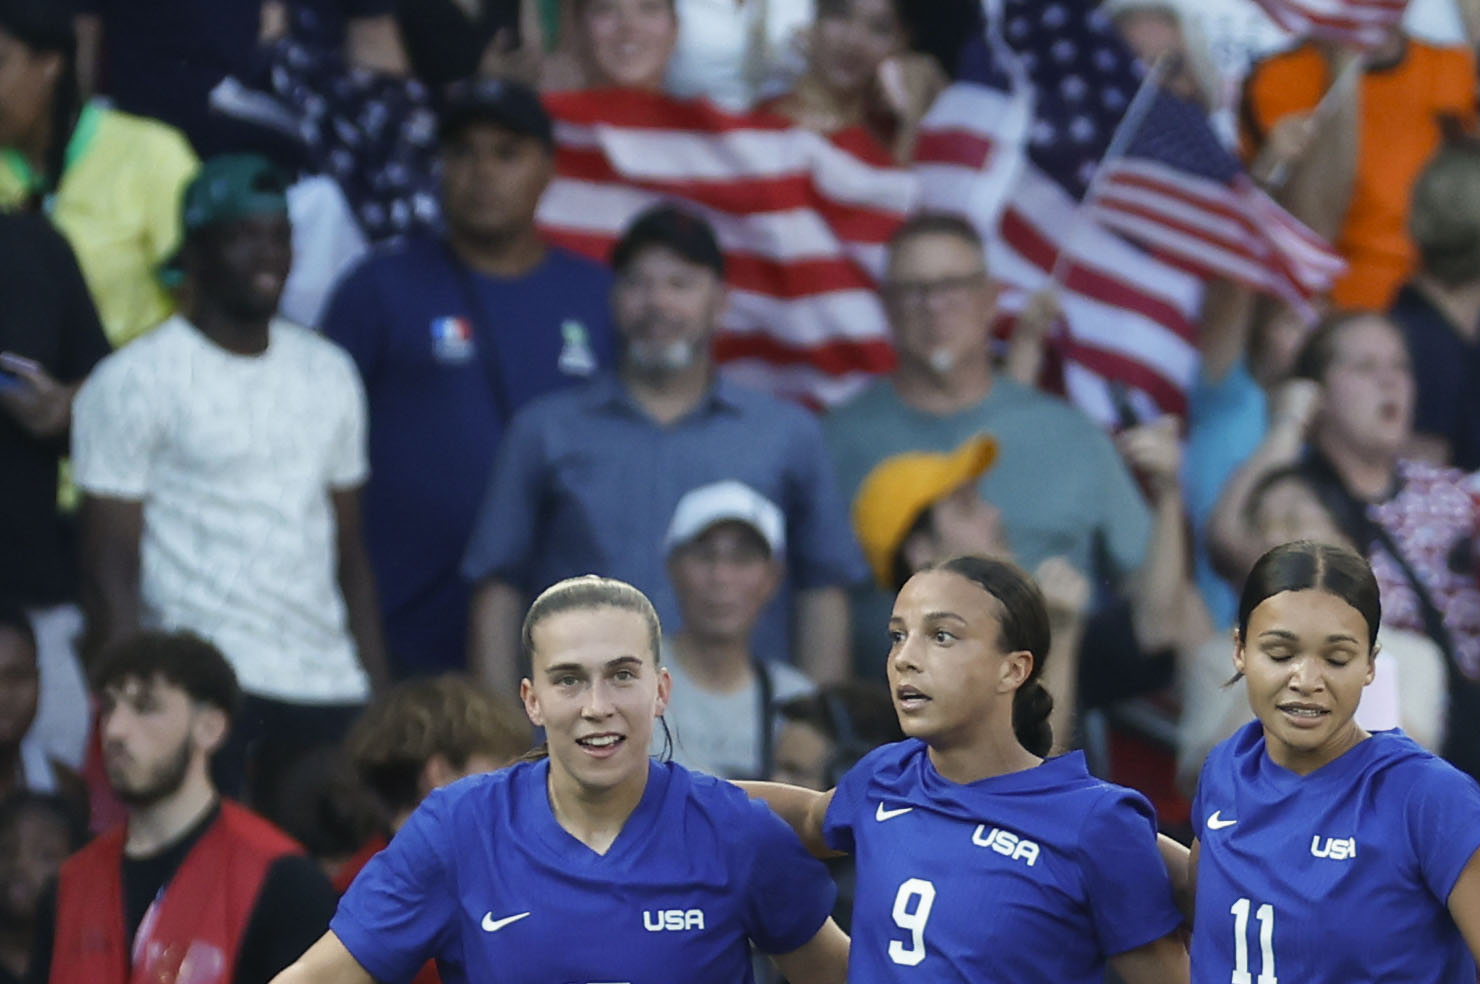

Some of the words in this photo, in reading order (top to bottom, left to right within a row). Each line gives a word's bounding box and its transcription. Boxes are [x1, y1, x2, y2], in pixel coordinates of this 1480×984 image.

[971, 824, 1040, 867] USA
[643, 909, 705, 932] USA
[888, 877, 937, 967] 9
